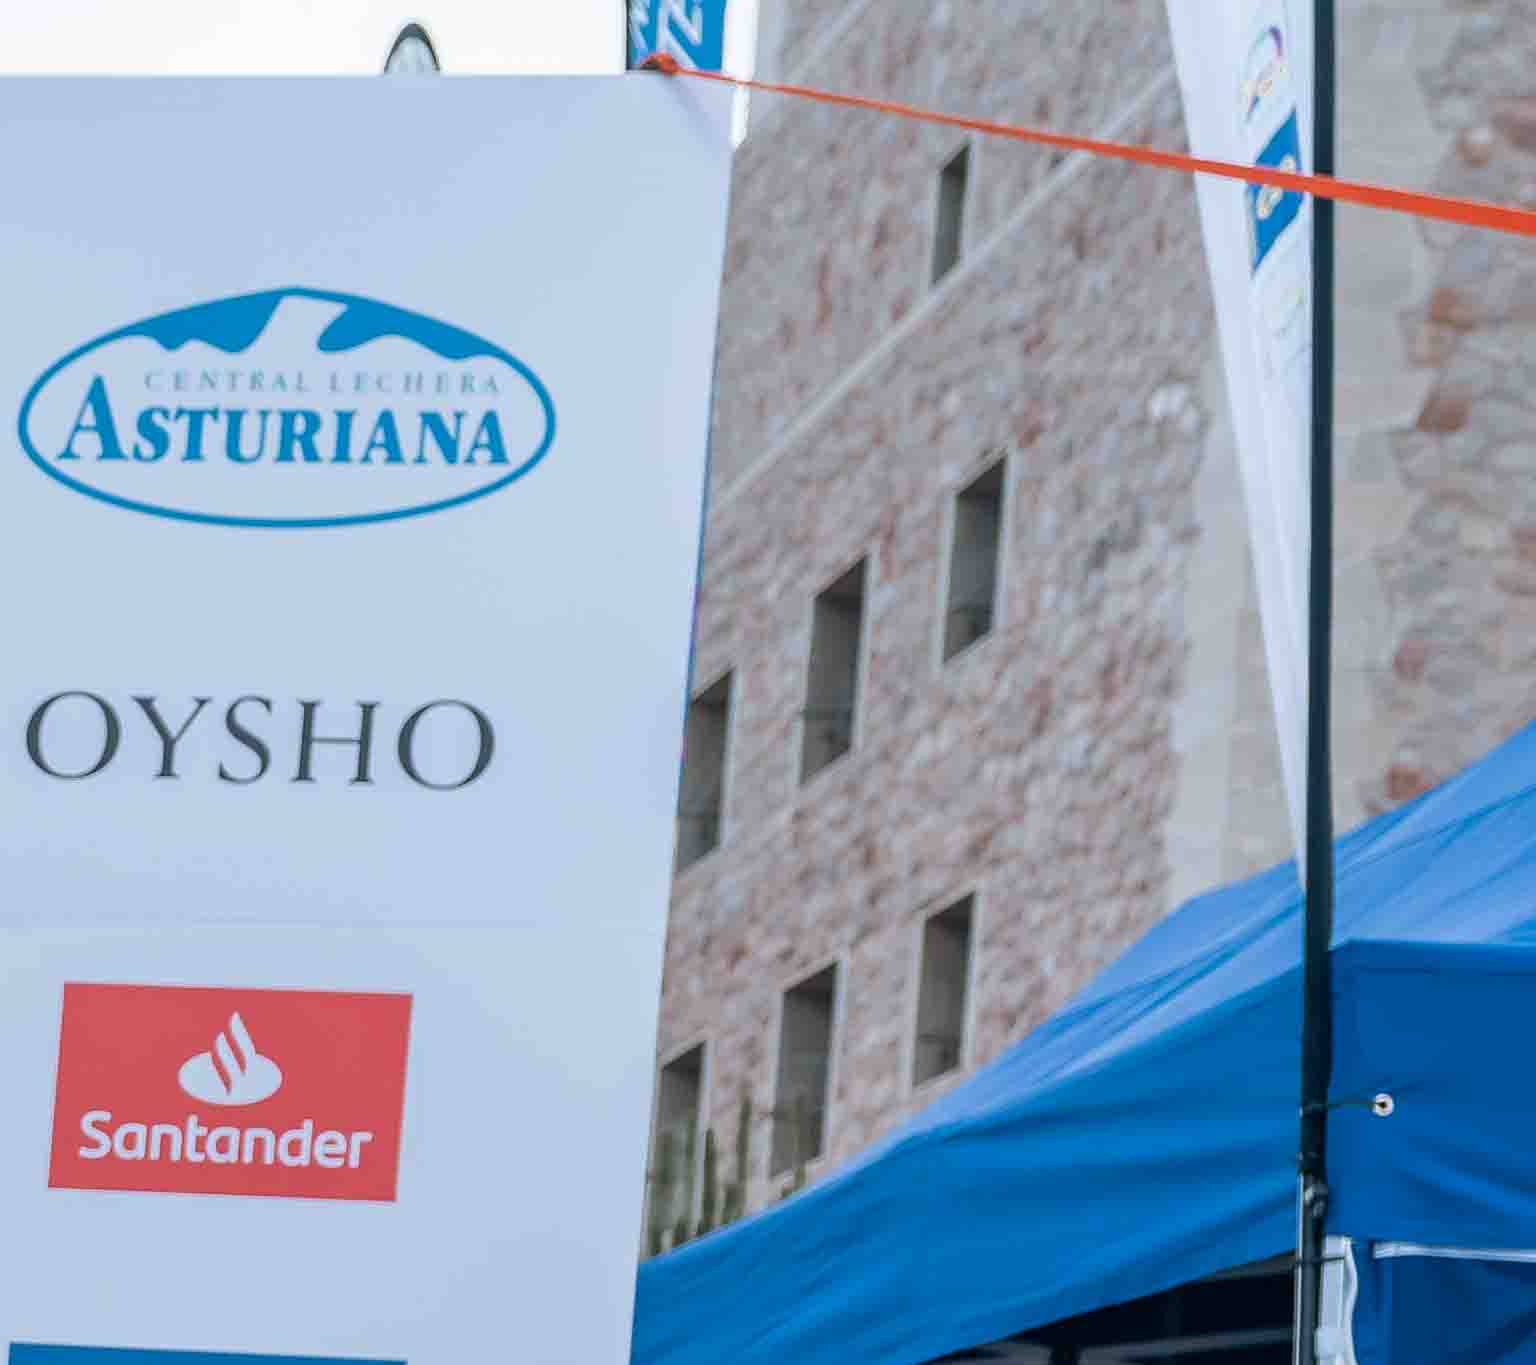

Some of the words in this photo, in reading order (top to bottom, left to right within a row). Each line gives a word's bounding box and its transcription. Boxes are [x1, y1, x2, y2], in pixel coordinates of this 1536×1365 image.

[58, 374, 511, 466] ASTURIANA
[144, 370, 310, 394] CENTRAL
[329, 372, 501, 397] LECHERA
[25, 690, 496, 792] OYSHO
[78, 1109, 372, 1170] Santander
